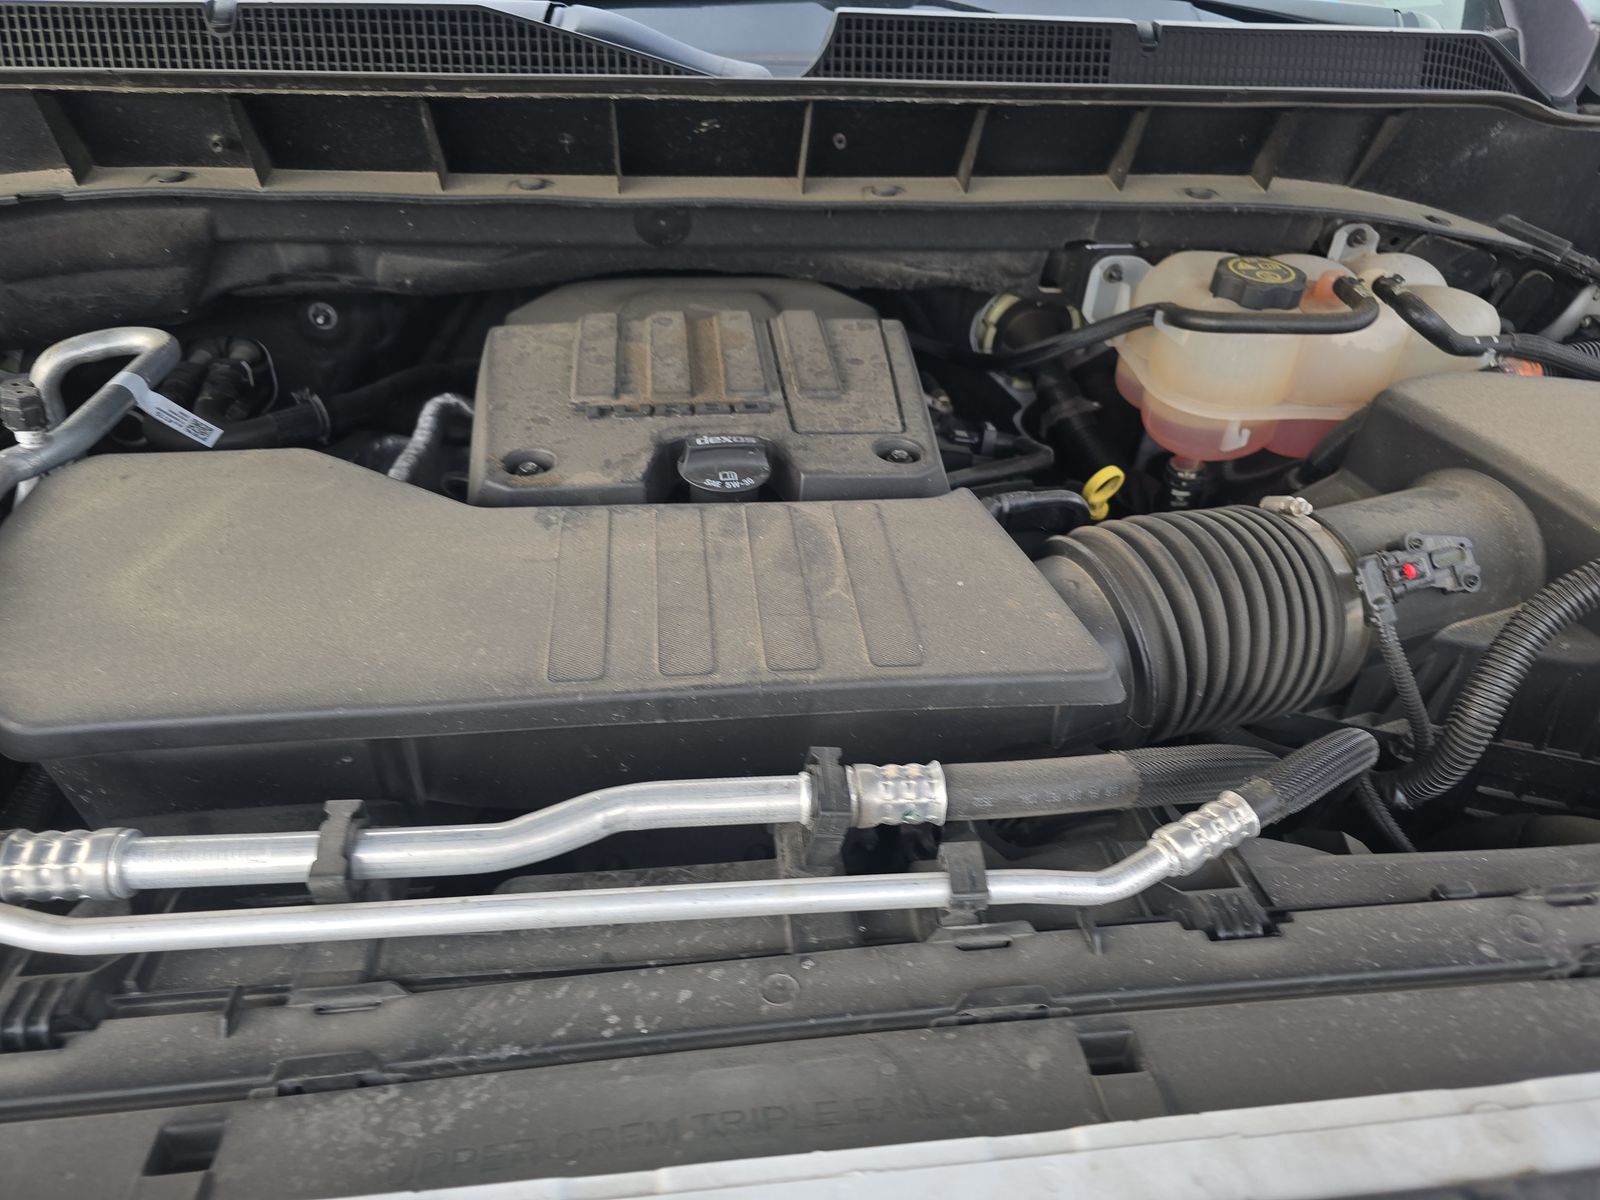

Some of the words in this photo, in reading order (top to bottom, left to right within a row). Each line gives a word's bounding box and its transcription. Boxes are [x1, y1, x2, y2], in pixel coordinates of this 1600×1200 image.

[696, 435, 757, 446] dexos
[703, 478, 722, 489] SAE
[725, 476, 755, 489] 5W-30
[690, 1099, 841, 1140] TRIPLE
